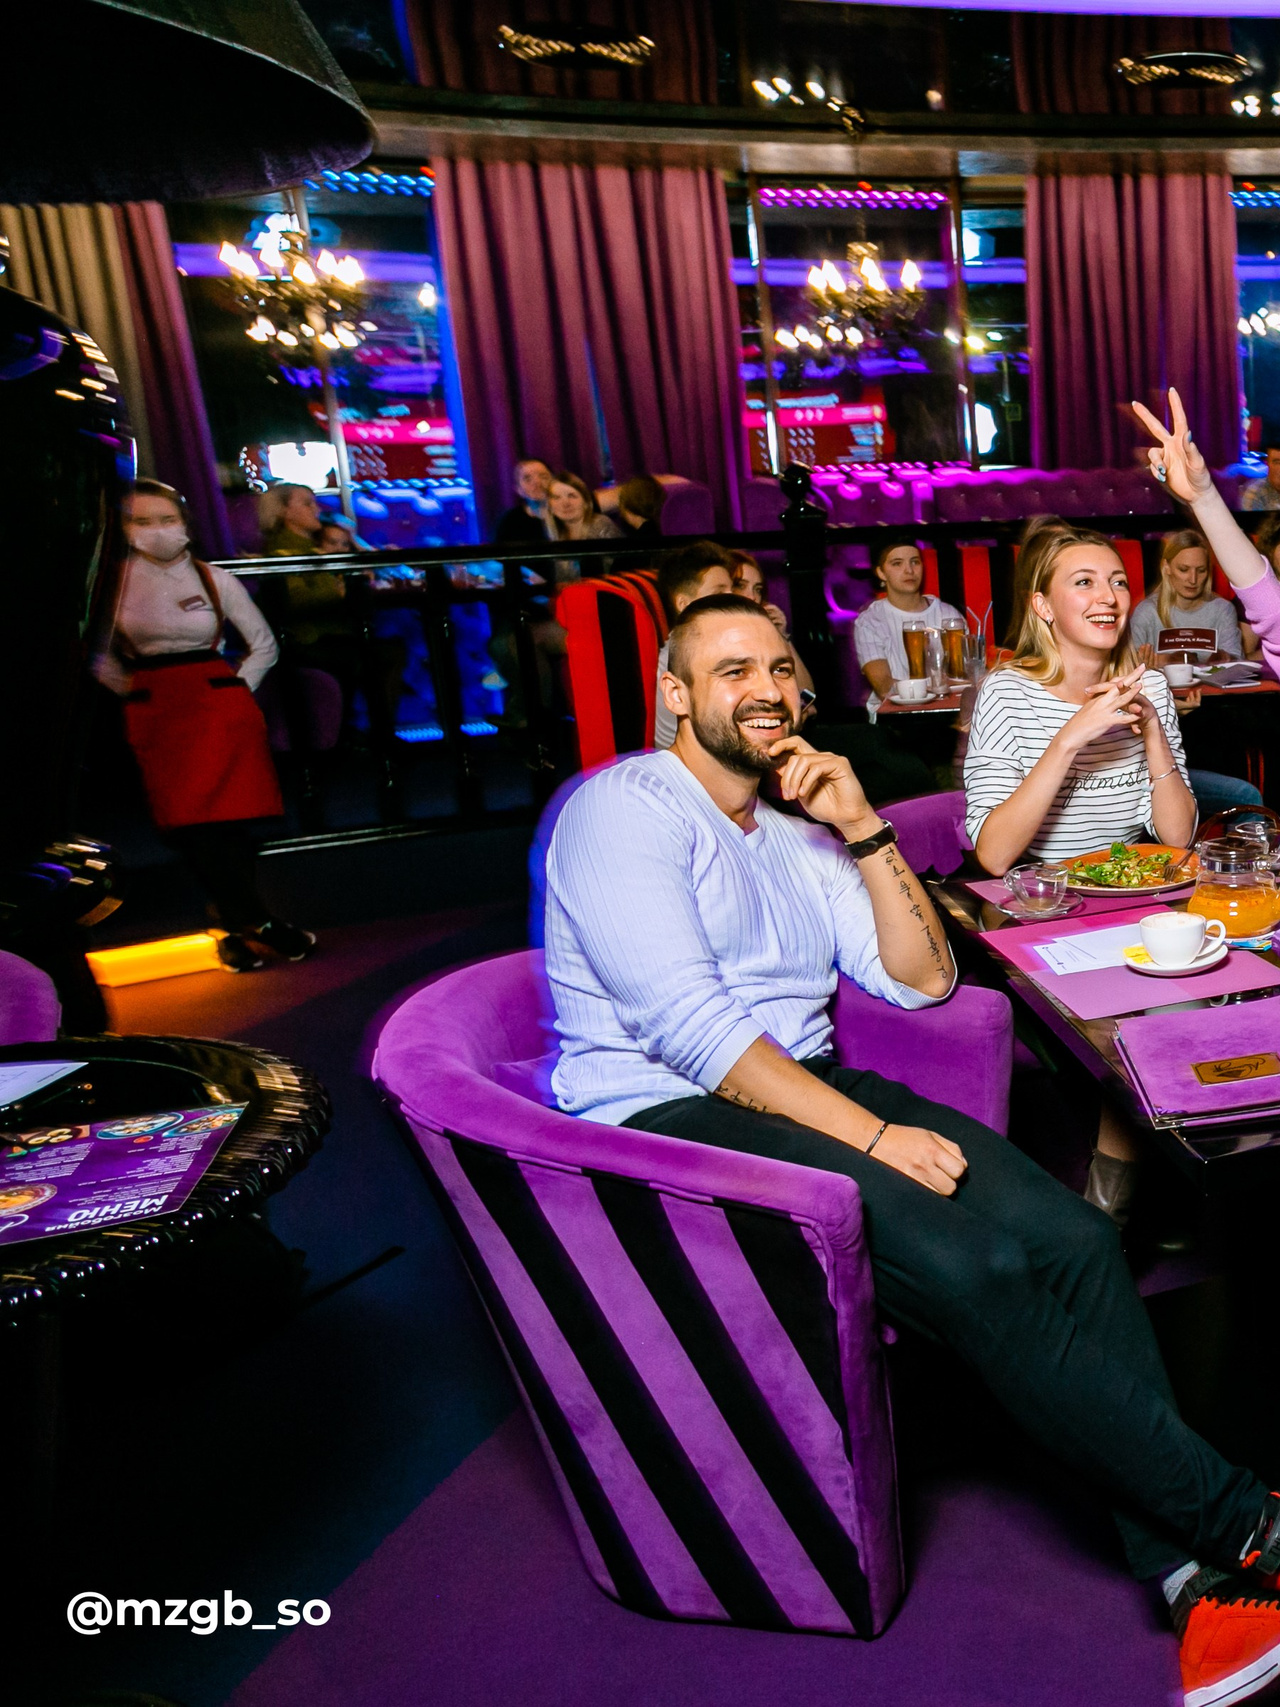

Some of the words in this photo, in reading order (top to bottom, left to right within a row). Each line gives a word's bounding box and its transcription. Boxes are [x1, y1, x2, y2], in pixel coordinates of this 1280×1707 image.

[1060, 761, 1148, 809] ptimist
[45, 1205, 162, 1232] Мозгобойня
[67, 1195, 169, 1222] МЕНЮ
